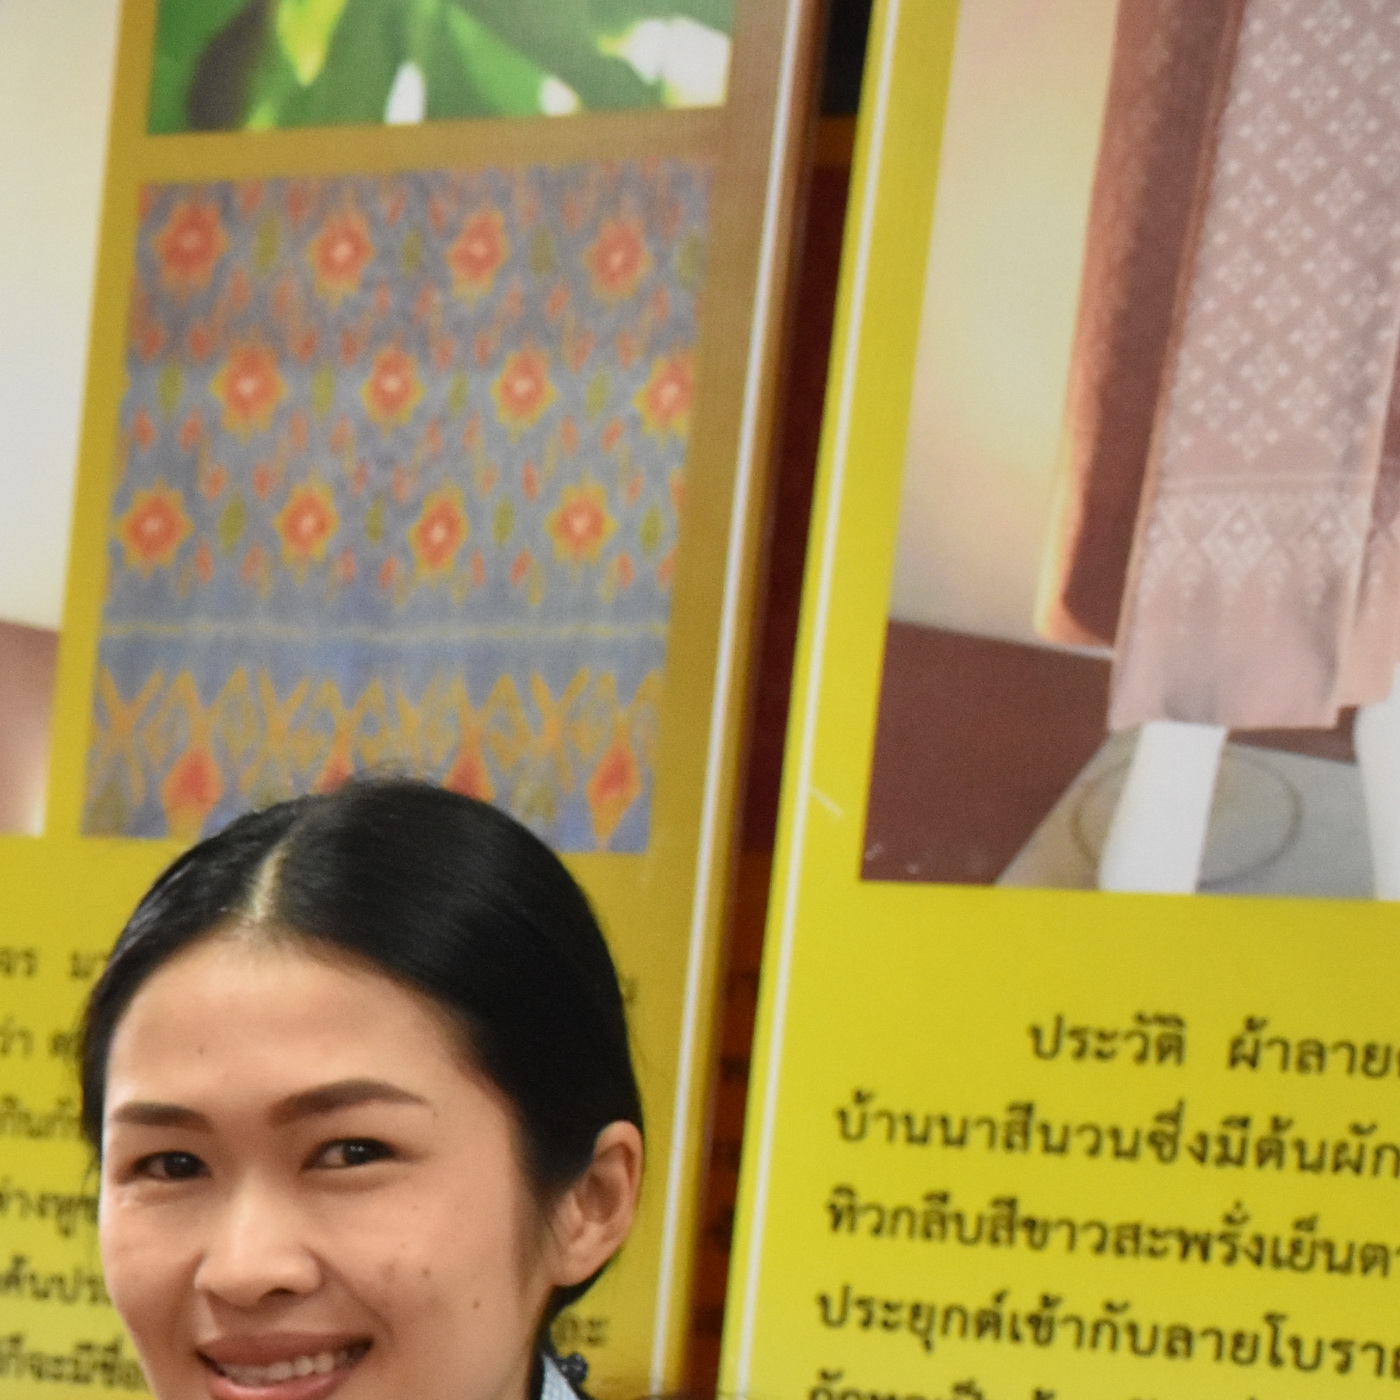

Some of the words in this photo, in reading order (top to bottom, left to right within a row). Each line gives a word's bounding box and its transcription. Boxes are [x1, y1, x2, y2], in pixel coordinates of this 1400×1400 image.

[1027, 1011, 1186, 1068] ประวัติ
[1226, 1016, 1400, 1079] ผ้าลาย
[828, 1183, 1400, 1280] ทิวกลีบสีขาวสะพรั่งเย็นต
